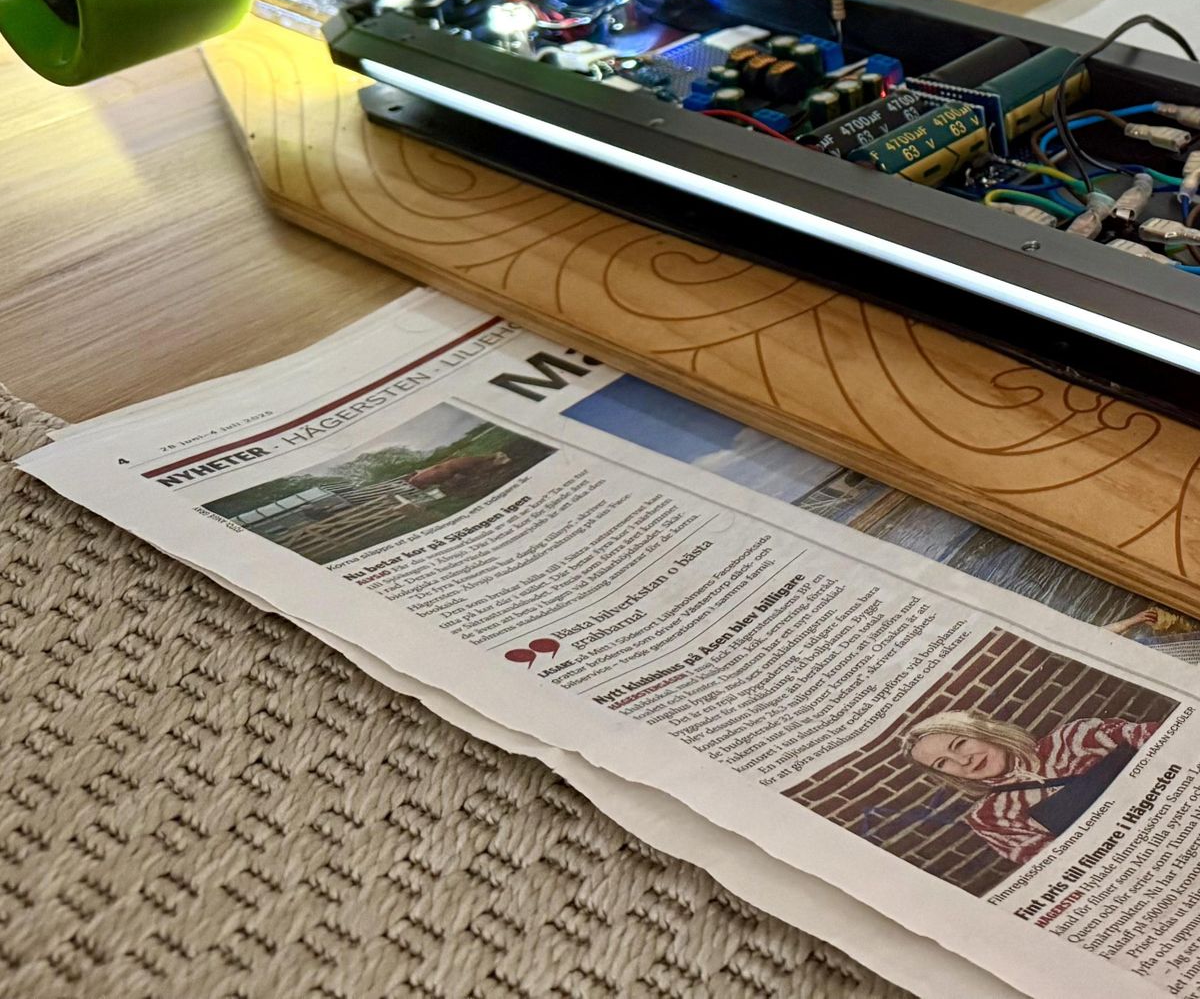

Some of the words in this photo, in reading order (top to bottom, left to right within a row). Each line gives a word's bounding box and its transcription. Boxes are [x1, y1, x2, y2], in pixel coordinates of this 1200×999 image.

[949, 120, 967, 137] 63
[902, 145, 921, 161] 63
[156, 445, 271, 488] NYHETER
[281, 372, 432, 446] HÄGERSTEN
[117, 457, 131, 466] 4
[342, 570, 366, 581] Nu
[363, 555, 403, 572] betar
[401, 547, 426, 558] kor
[427, 539, 446, 550] på
[444, 512, 504, 542] Sjöängen
[500, 495, 531, 513] igen
[551, 620, 595, 639] Bästa
[591, 575, 669, 622] bilverkstan
[674, 540, 713, 566] bästa
[571, 608, 647, 650] grabbarna!
[592, 688, 626, 704] Nytt
[622, 663, 685, 691] klubbhus
[683, 652, 703, 666] på
[699, 632, 734, 655] Åsen
[728, 611, 758, 633] blev
[754, 574, 805, 612] billigare
[1123, 764, 1182, 824] Hägersten
[1117, 821, 1131, 830] i
[987, 854, 1057, 905] Filmregissören
[1052, 831, 1083, 855] Sanna
[1078, 800, 1115, 831] Lenken.
[1034, 889, 1085, 928] HÄGERSTEN
[1079, 863, 1117, 891] Hyllade
[1112, 803, 1171, 864] filmregissören
[1166, 775, 1195, 802] Sanna
[1049, 914, 1079, 936] känd
[1073, 904, 1092, 917] för
[1087, 883, 1118, 905] filmer
[1116, 867, 1136, 884] som
[1130, 848, 1154, 867] Min
[1148, 829, 1170, 847] lilla
[1167, 801, 1191, 829] syster
[1079, 830, 1125, 868] filmare
[1041, 881, 1068, 903] pris
[1062, 865, 1086, 882] till
[1067, 918, 1102, 943] Queen
[1099, 904, 1119, 918] och
[1113, 892, 1131, 905] för
[1129, 870, 1154, 893] serier
[1152, 851, 1173, 871] som
[1166, 821, 1197, 849] Tunna
[1014, 899, 1046, 920] Fint
[1083, 900, 1150, 952] Smärtpunkten.
[1143, 886, 1163, 899] Nu
[1156, 869, 1177, 886] har
[1099, 928, 1136, 960] Falstaff
[1133, 921, 1148, 934] på
[1126, 935, 1157, 958] Priset
[1152, 916, 1178, 936] delas
[1175, 907, 1188, 917] ut
[1132, 957, 1158, 976] lyfta
[1155, 942, 1175, 957] och
[1167, 978, 1187, 995] det
